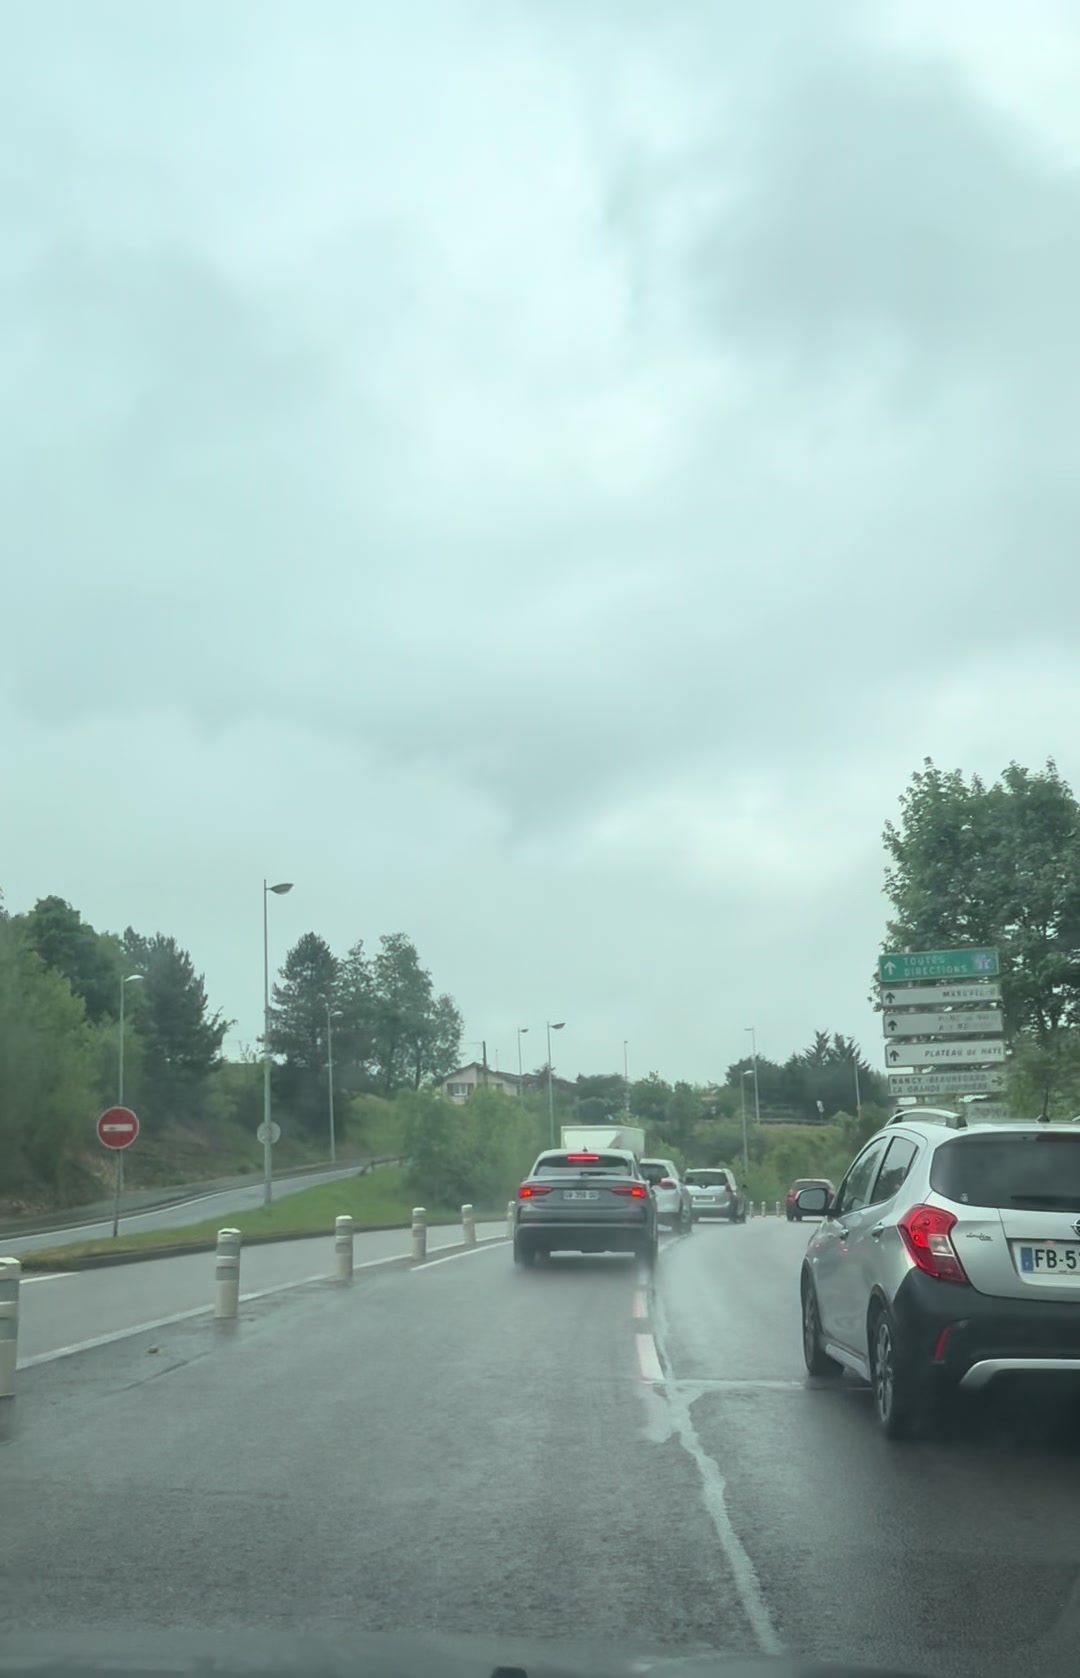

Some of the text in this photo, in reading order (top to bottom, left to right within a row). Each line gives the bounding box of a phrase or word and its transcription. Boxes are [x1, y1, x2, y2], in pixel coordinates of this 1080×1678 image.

[903, 955, 945, 966] TOUTES
[903, 964, 969, 977] DIRECTIONS
[924, 1048, 963, 1057] PLATEAU
[1035, 1248, 1080, 1270] FB-5
